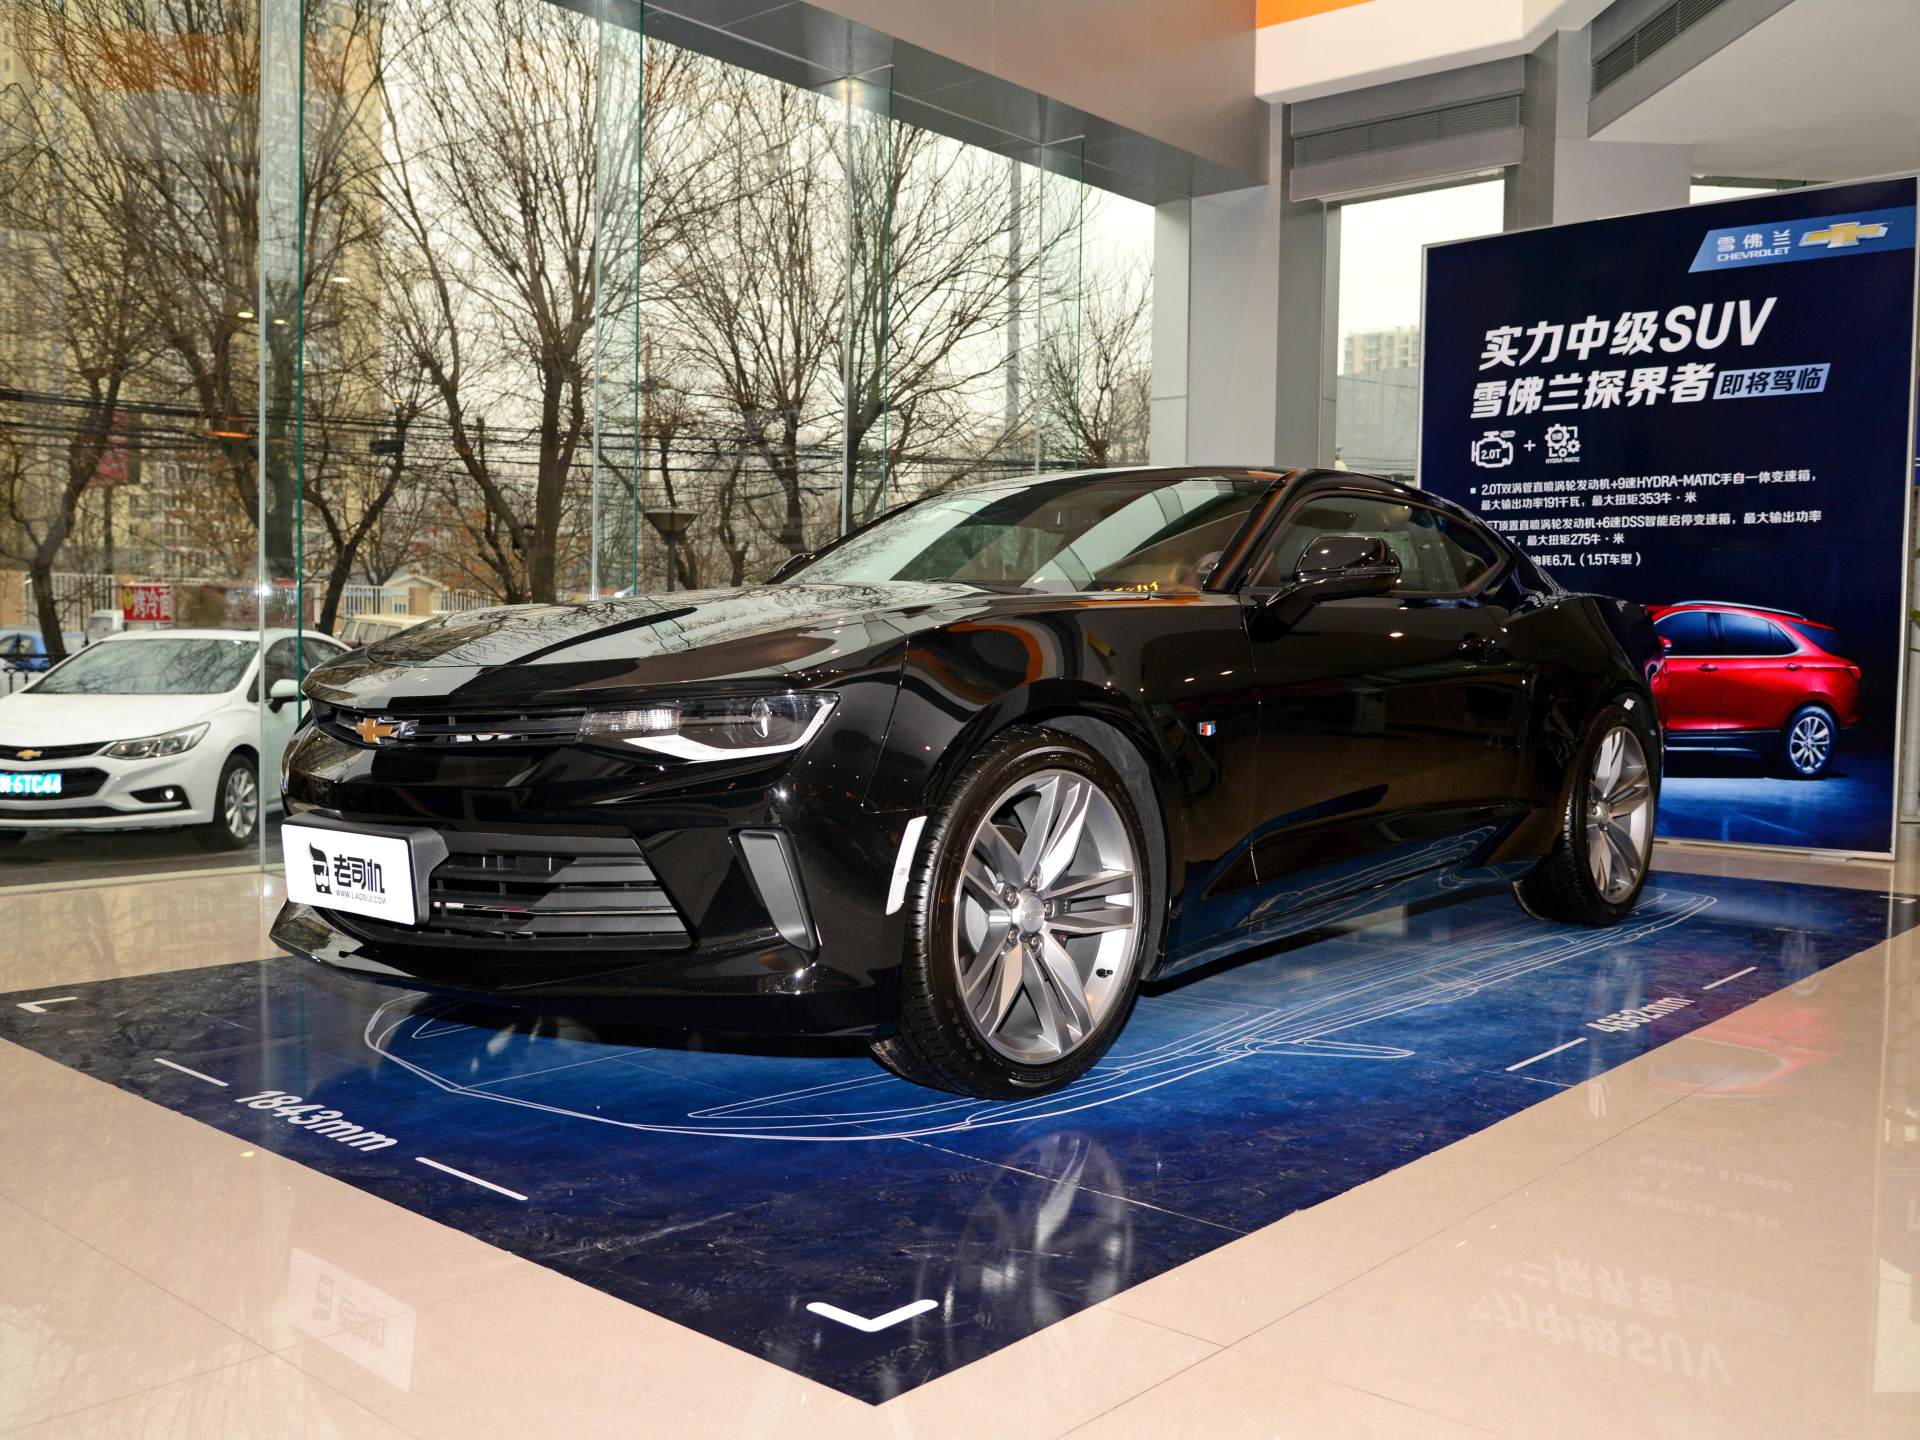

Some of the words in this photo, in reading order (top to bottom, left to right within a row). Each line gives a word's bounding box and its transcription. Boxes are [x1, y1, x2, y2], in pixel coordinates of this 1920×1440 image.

[1716, 229, 1791, 252] 雪佛兰
[1716, 246, 1791, 262] CHEVROLET
[1479, 297, 1778, 371] 实力中级SUV
[1470, 363, 1716, 419] 雪佛兰探界者
[1719, 367, 1825, 397] 即将驾临
[1480, 448, 1501, 460] 2.0T
[333, 853, 385, 894] 老司机
[1586, 997, 1696, 1032] 4652mm
[235, 1090, 398, 1152] 1843mm
